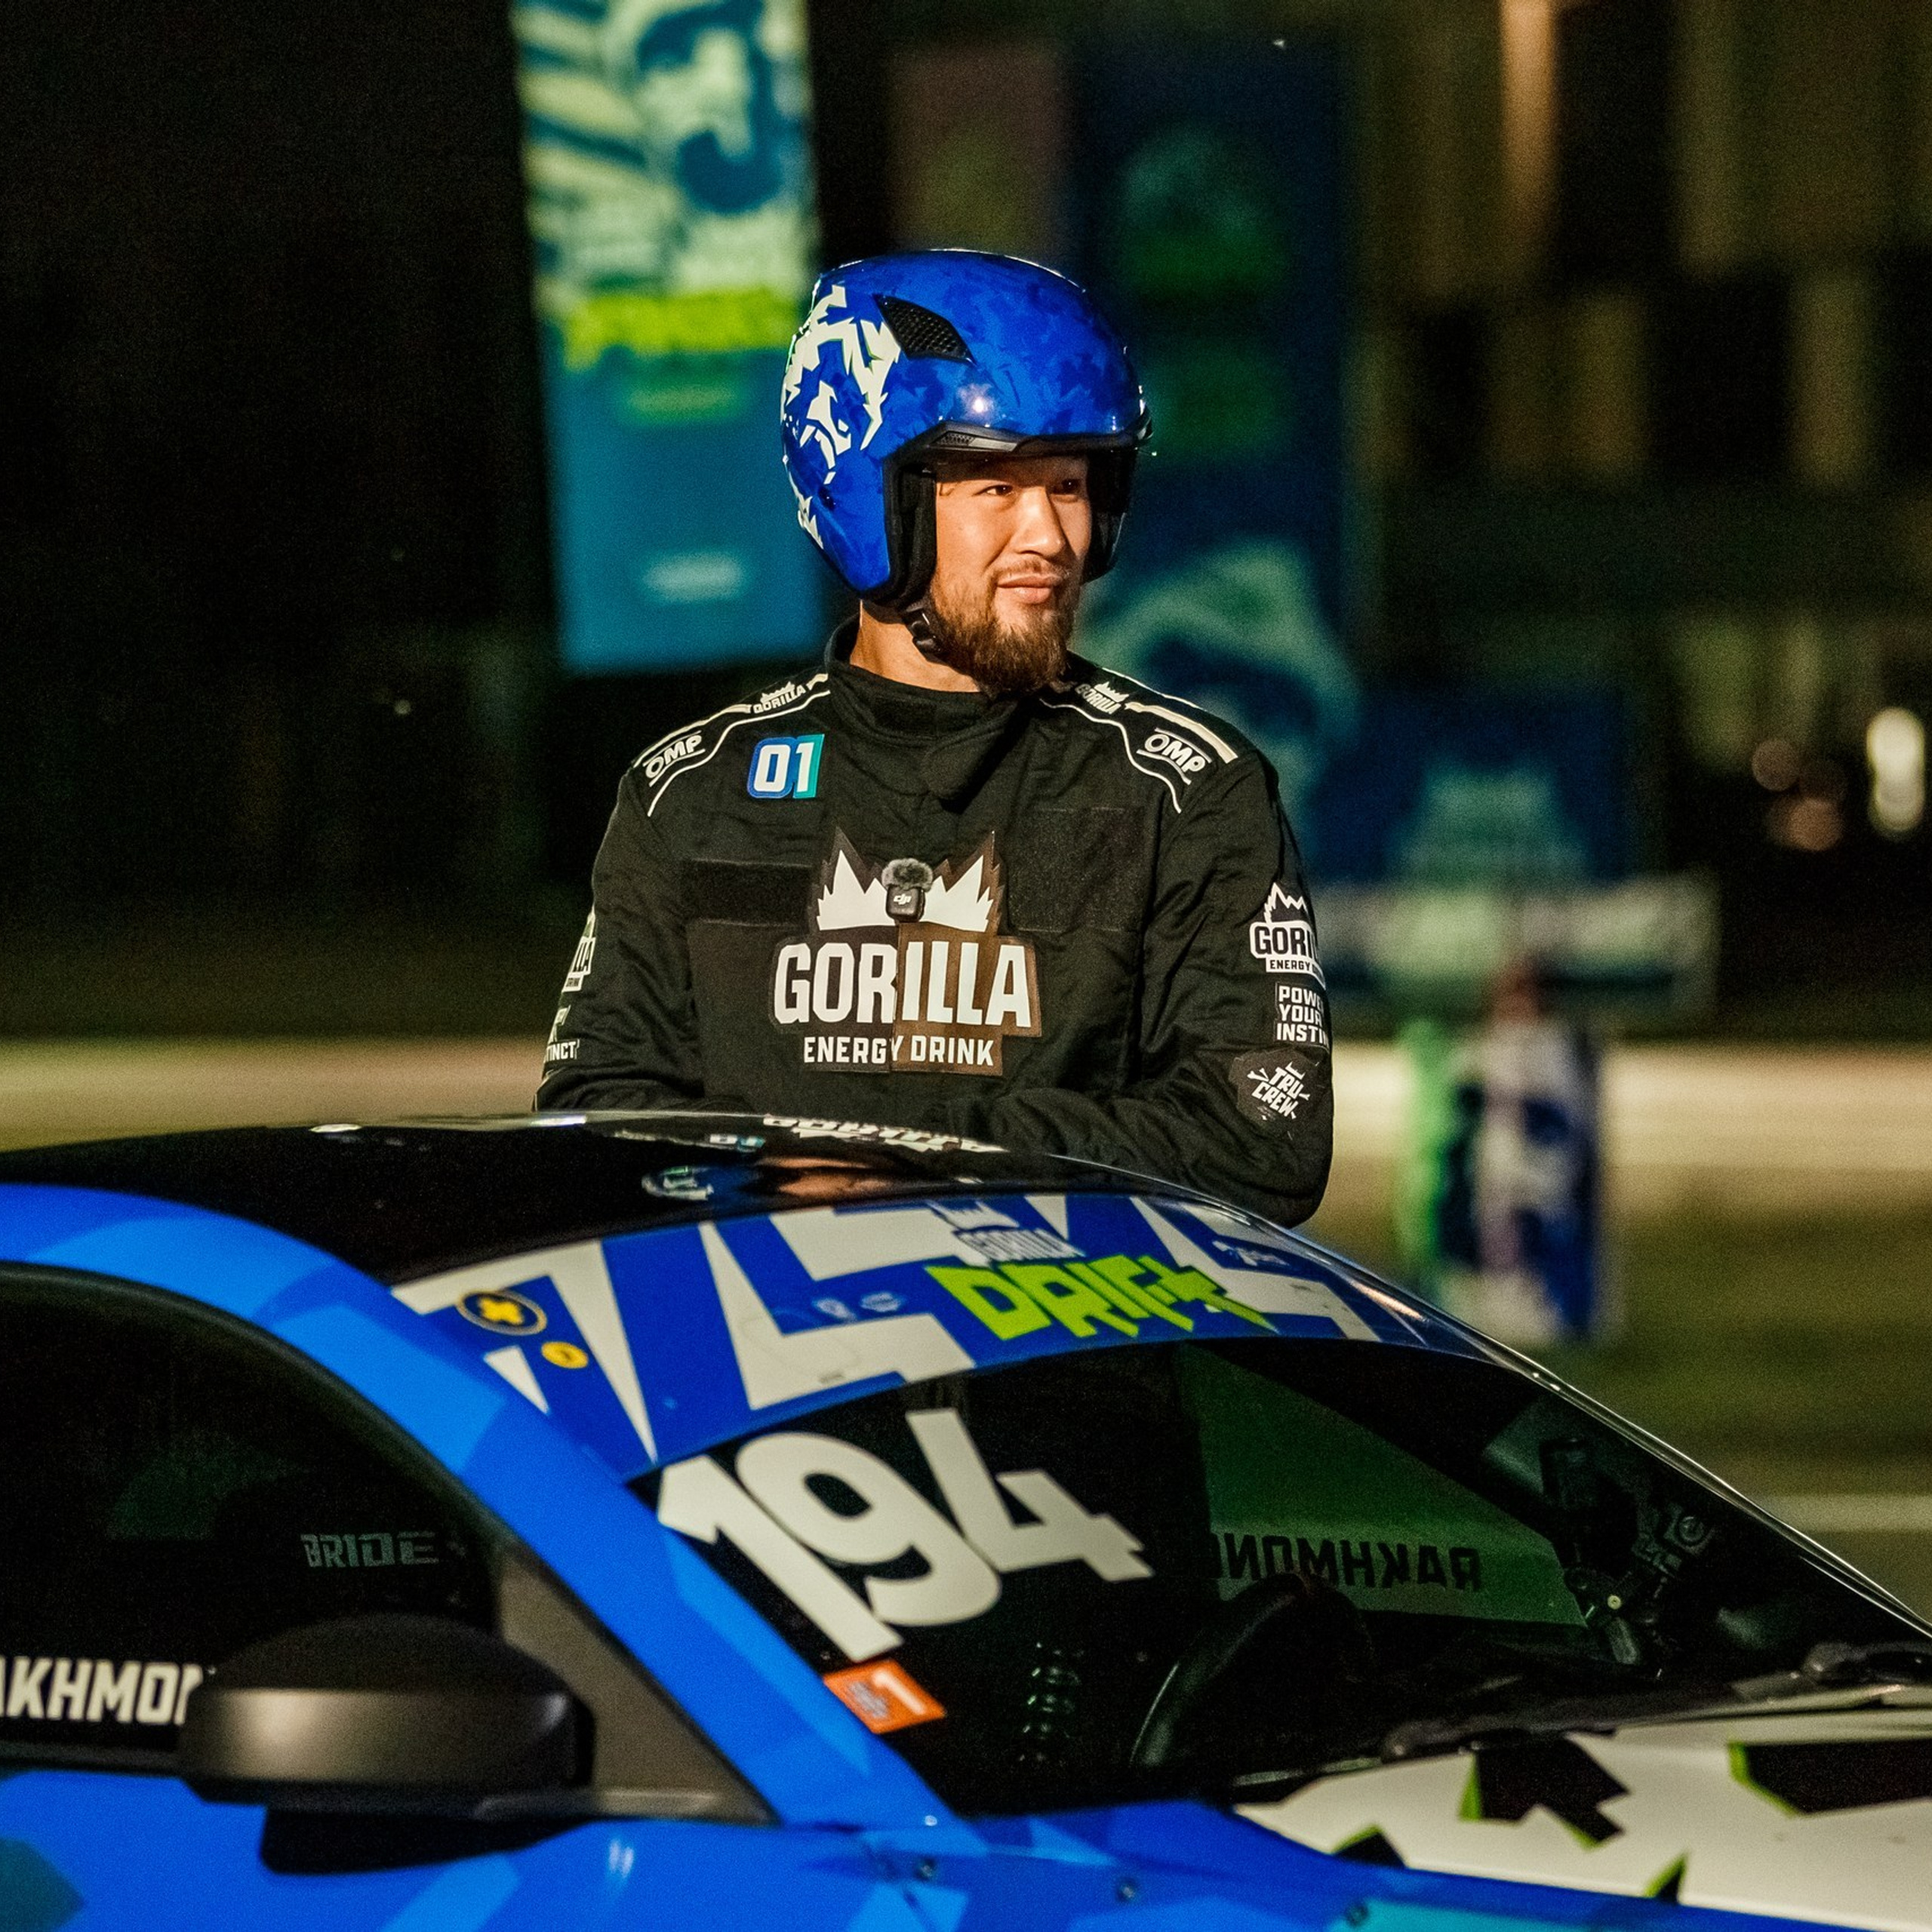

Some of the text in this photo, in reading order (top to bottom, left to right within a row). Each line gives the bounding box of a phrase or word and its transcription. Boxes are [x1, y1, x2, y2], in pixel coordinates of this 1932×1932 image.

[752, 685, 807, 715] GORILLA
[645, 734, 703, 779] OMP
[753, 742, 815, 793] 01
[1144, 733, 1207, 773] OMP
[1254, 925, 1318, 960] GORI
[774, 940, 1032, 1028] GORILLA
[1269, 959, 1312, 972] ENERGY
[803, 1035, 995, 1066] ENERGY DRINK
[1251, 1081, 1299, 1117] CREW
[1268, 1066, 1305, 1100] TRU
[300, 1531, 440, 1568] BRIDE
[657, 1407, 1154, 1663] 194
[0, 1656, 203, 1725] KHMO
